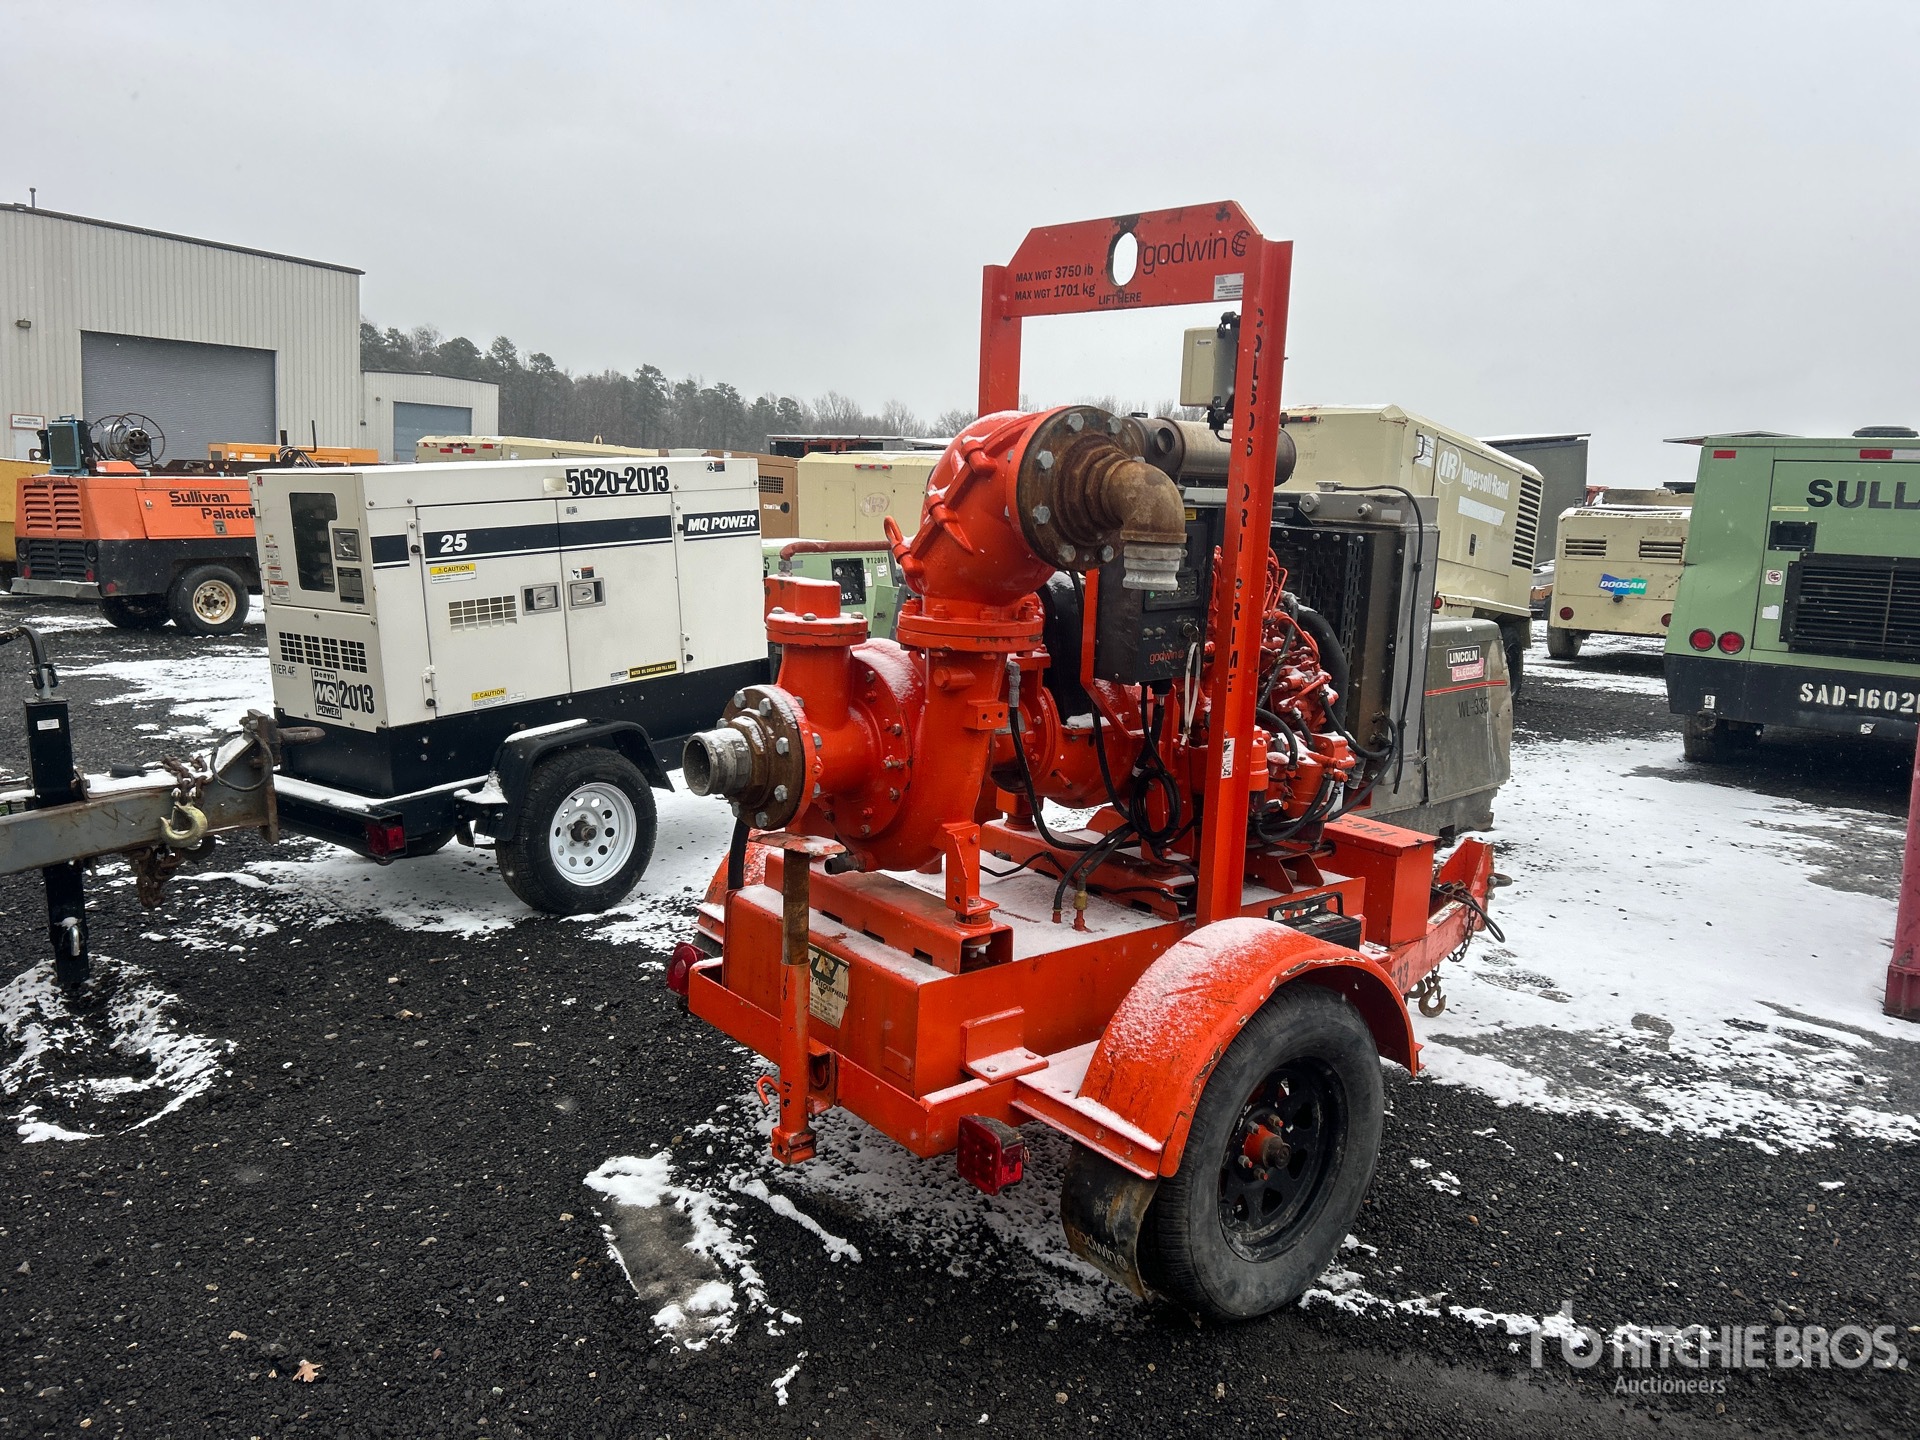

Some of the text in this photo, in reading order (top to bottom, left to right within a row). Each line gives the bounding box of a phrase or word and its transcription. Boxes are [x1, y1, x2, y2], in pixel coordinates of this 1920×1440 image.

[1143, 233, 1227, 275] godwin
[1016, 272, 1033, 283] MAX
[1035, 270, 1052, 281] WGT
[1055, 265, 1081, 279] 3750
[1014, 282, 1096, 301] MAX WGT 1701 kg
[1098, 292, 1142, 305] LIFT HERE
[1440, 450, 1459, 480] IR
[566, 465, 669, 496] 5620-2013
[169, 491, 230, 503] Sullivan
[1806, 478, 1920, 510] SULL
[688, 514, 756, 532] MQ POWER
[440, 533, 468, 553] 25
[443, 565, 470, 573] CAUTION
[1600, 580, 1647, 589] DOOSAN
[1149, 652, 1178, 665] godwin
[1449, 650, 1478, 663] LINCOLN
[273, 663, 286, 674] TIER
[314, 671, 335, 680] Denyo
[315, 680, 375, 714] MQ 2013
[479, 689, 505, 698] CAUTION
[317, 704, 340, 717] POWER
